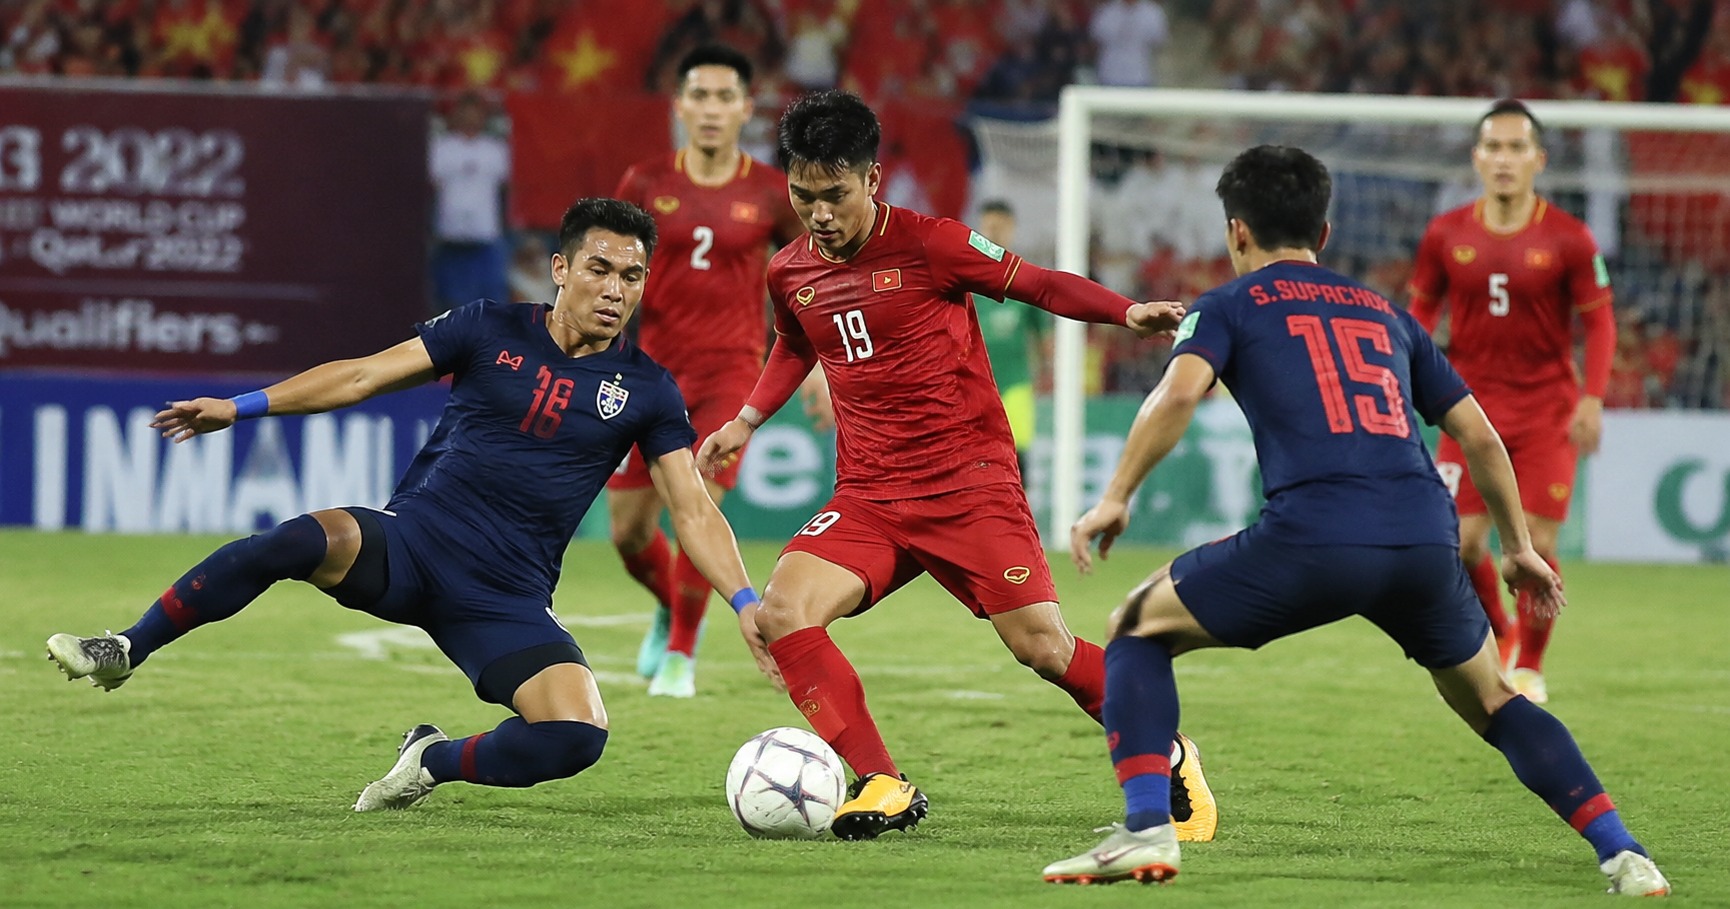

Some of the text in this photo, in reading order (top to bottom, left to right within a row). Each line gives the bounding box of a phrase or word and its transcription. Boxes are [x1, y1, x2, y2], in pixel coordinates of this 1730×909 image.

[60, 127, 246, 197] 2022
[690, 225, 714, 271] 2
[1488, 272, 1510, 317] 5
[832, 309, 874, 363] 19
[519, 364, 575, 440] 16
[1286, 314, 1411, 439] 15
